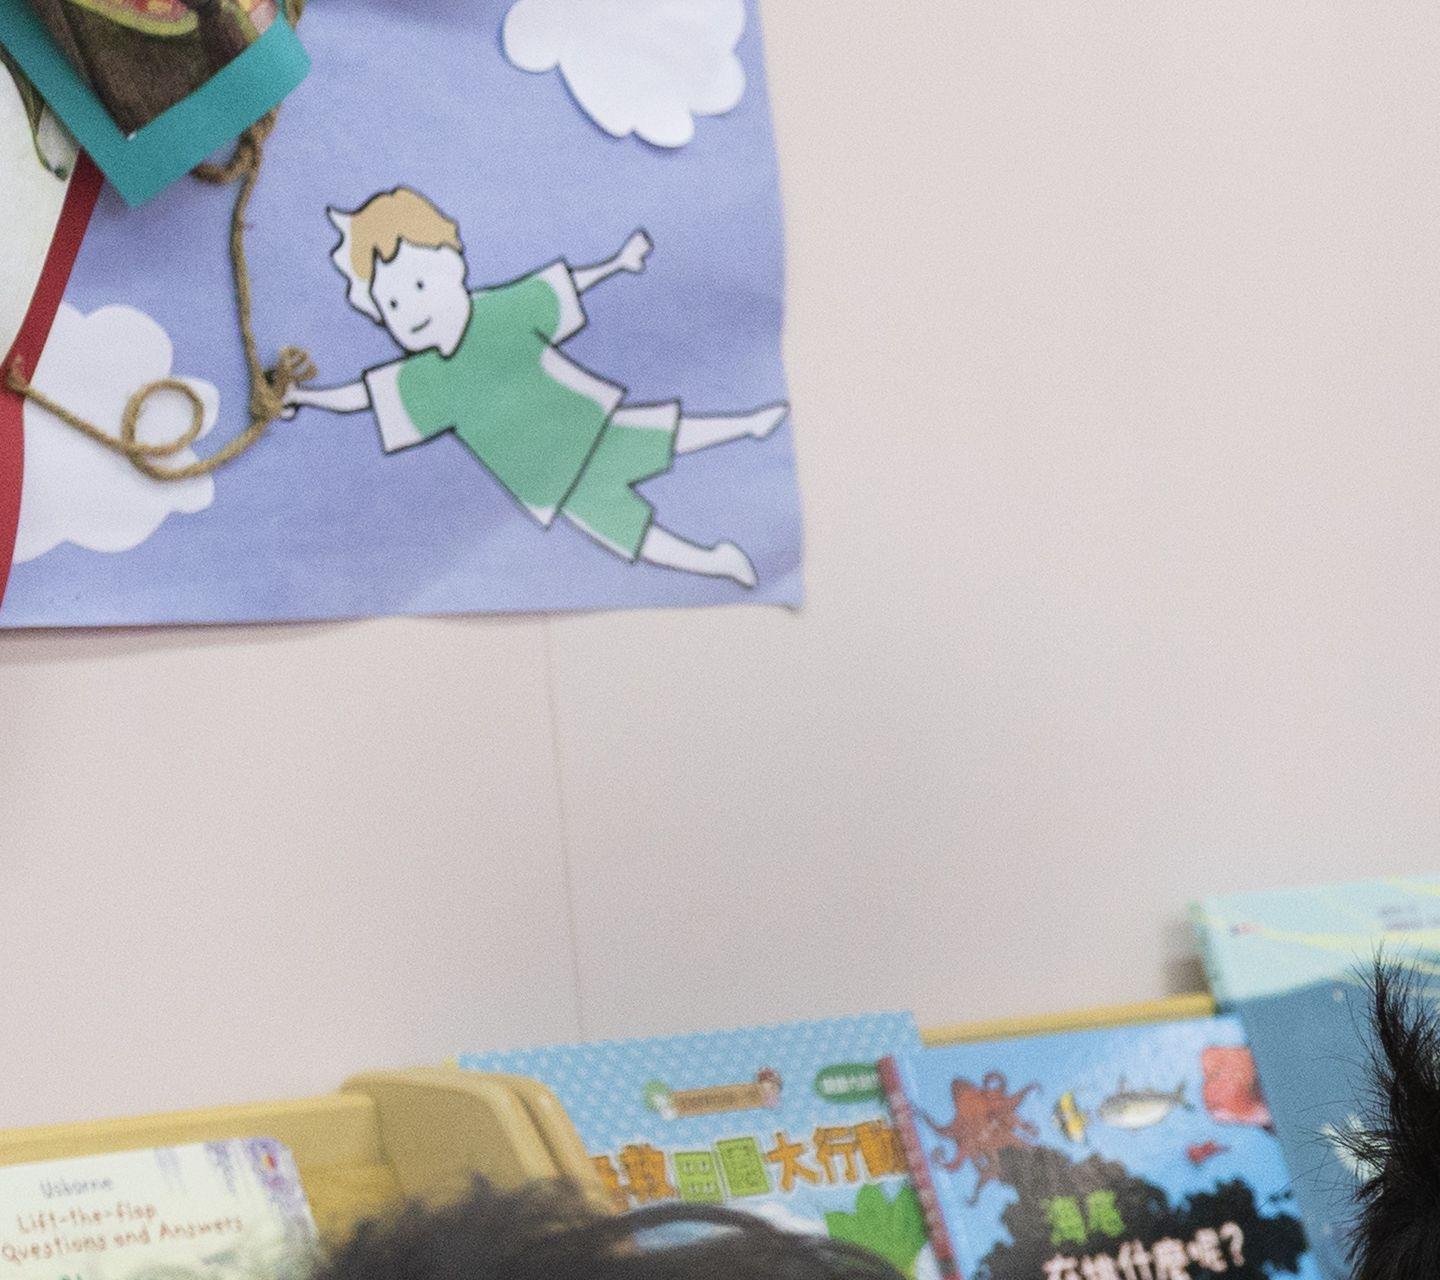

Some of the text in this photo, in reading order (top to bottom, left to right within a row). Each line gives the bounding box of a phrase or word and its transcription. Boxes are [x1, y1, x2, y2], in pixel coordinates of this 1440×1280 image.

[40, 1177, 113, 1199] Usborne
[1, 1216, 243, 1264] Questions and Answers
